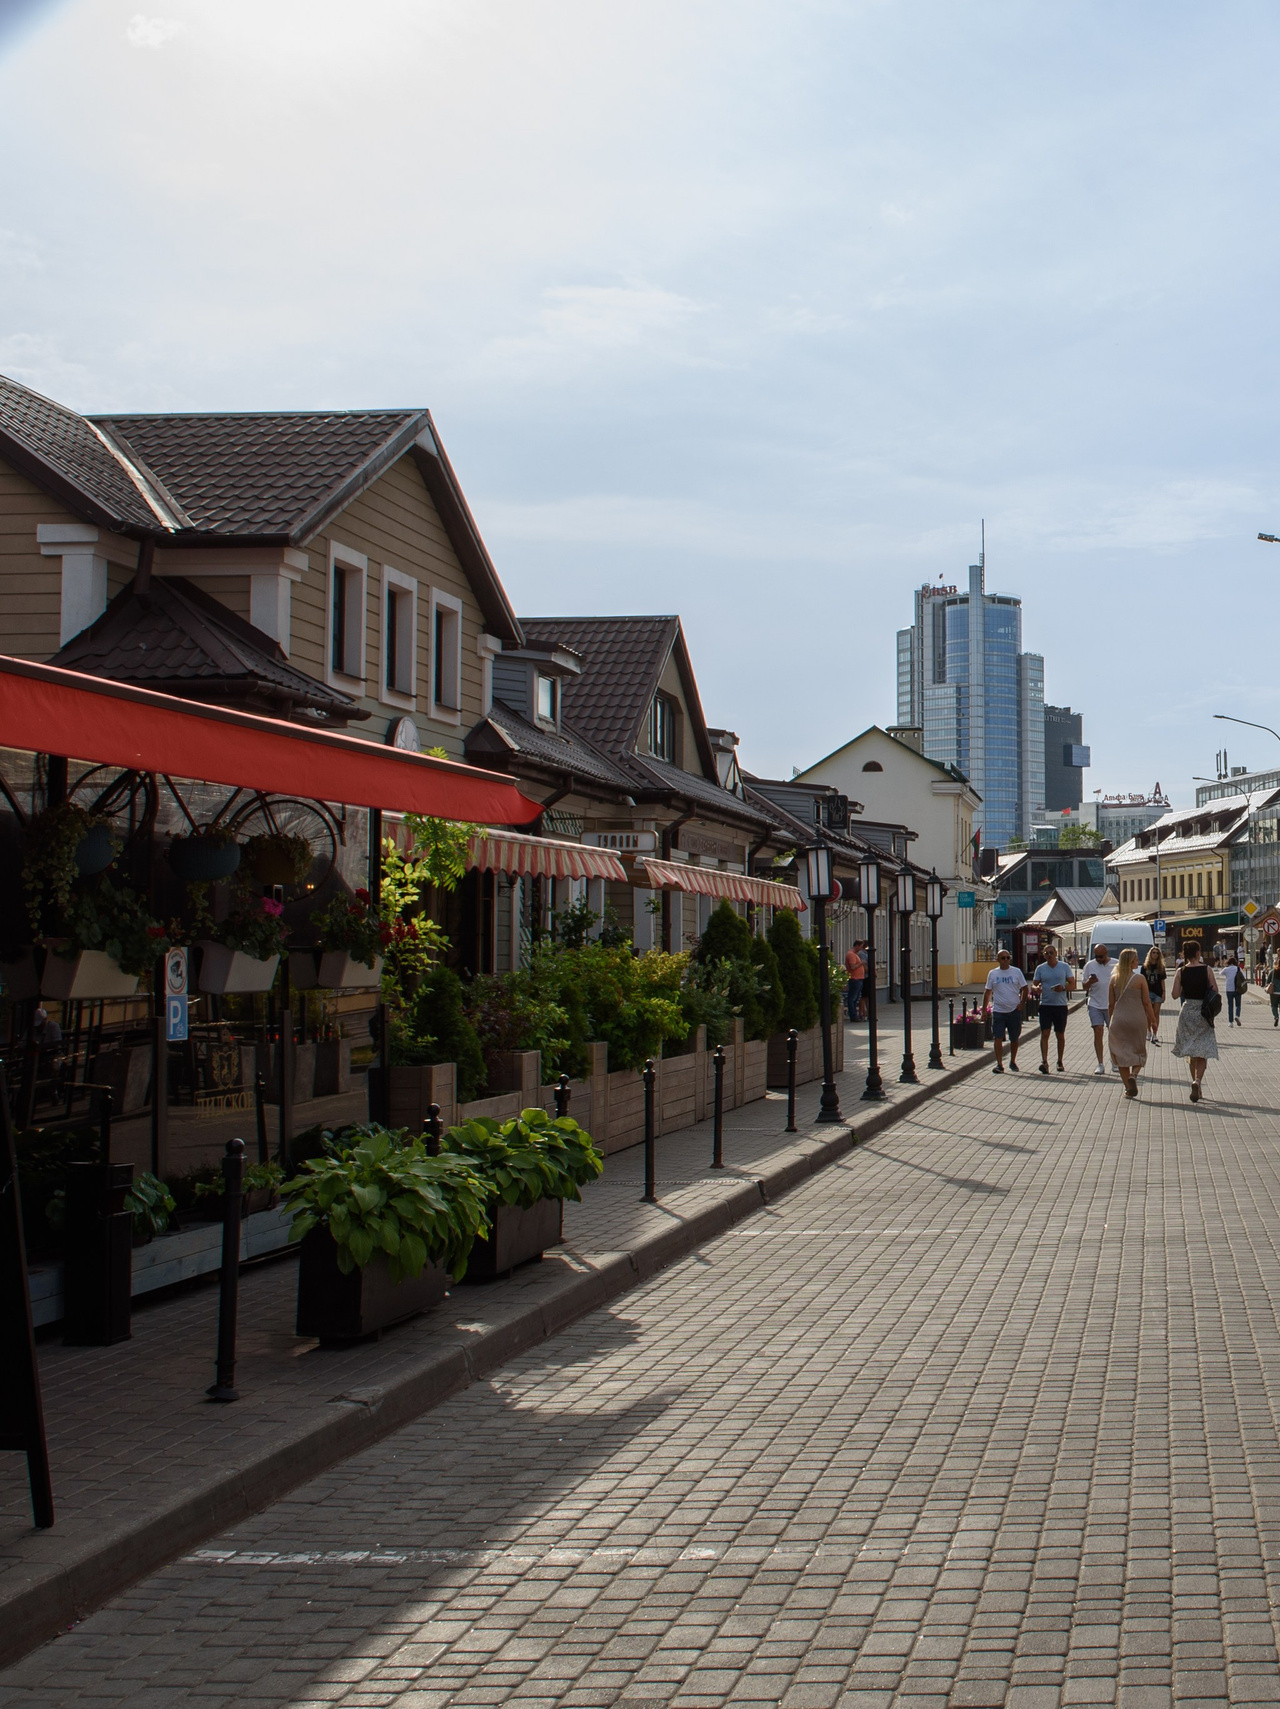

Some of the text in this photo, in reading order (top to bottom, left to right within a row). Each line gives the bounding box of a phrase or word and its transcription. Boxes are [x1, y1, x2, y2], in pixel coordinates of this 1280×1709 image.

[1157, 921, 1163, 930] P
[1181, 928, 1203, 938] LOKI
[170, 1001, 182, 1035] P
[196, 1090, 255, 1114] ЛИДСКОЕ
